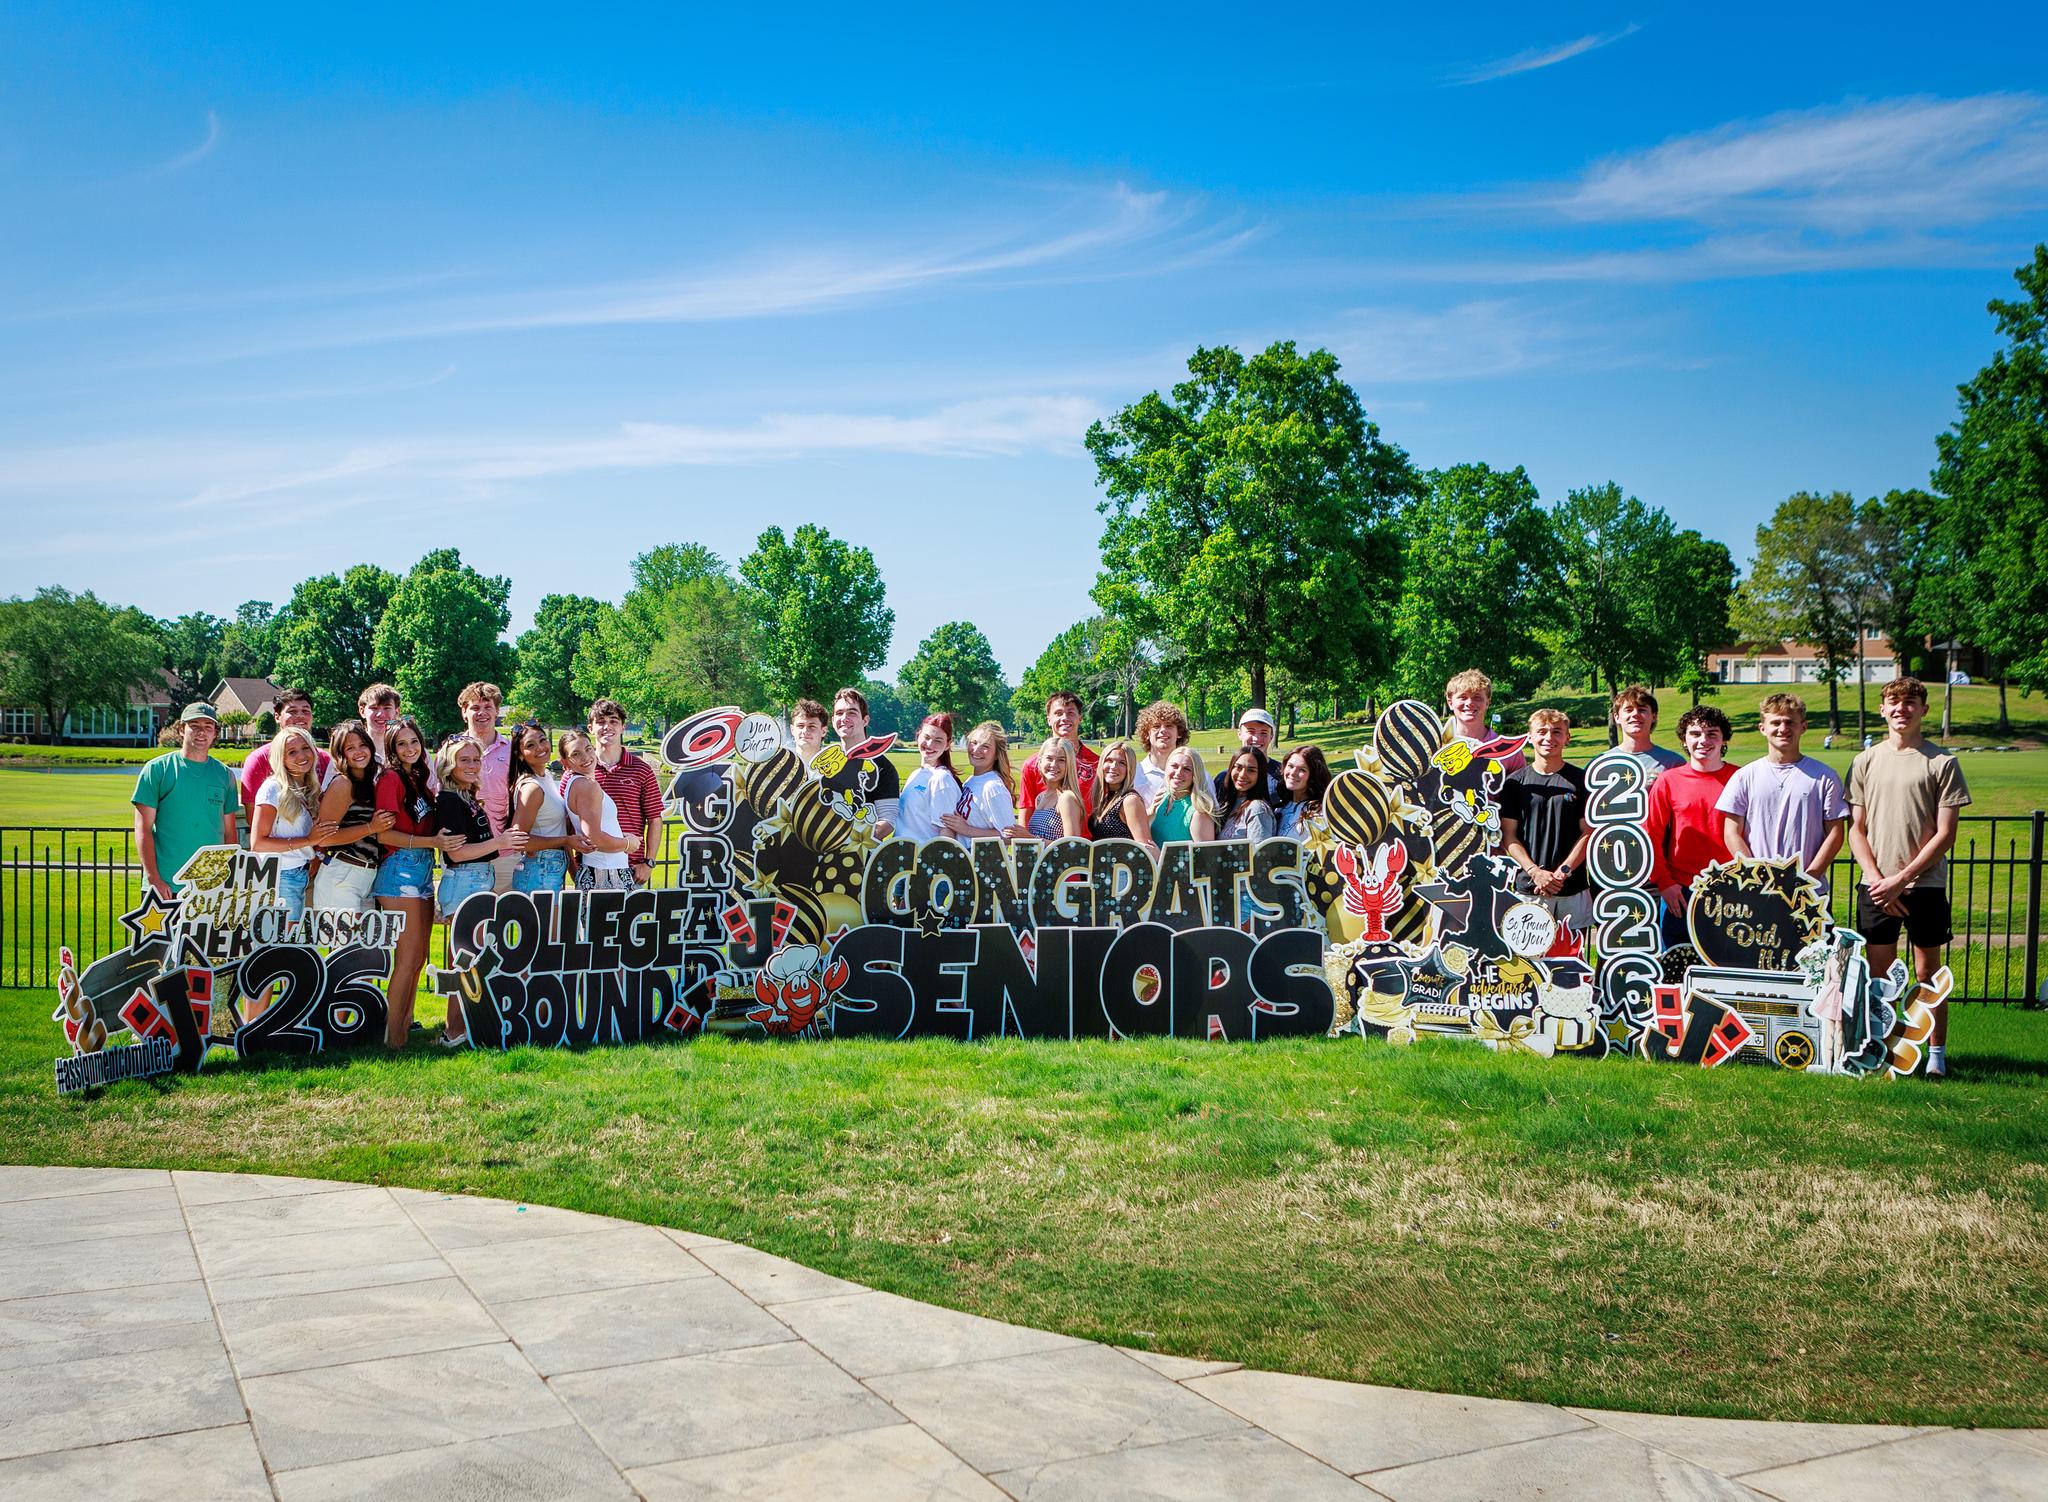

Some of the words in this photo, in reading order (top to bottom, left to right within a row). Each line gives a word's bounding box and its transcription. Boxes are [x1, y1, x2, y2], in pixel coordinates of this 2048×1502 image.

[749, 721, 772, 739] You
[224, 854, 279, 890] I'M
[862, 837, 1306, 934] CONGRATS
[1586, 756, 1664, 1020] 2026
[1506, 917, 1518, 931] So
[1521, 913, 1551, 931] Proud
[1704, 894, 1753, 927] You
[252, 908, 356, 950] CLASS
[361, 909, 404, 950] OF
[451, 890, 690, 973] COLLEGE
[1511, 930, 1521, 945] of
[1520, 930, 1550, 951] You!
[1726, 921, 1781, 949] Did
[237, 945, 394, 1056] 26
[827, 923, 1336, 1042] SENIORS
[1411, 983, 1442, 999] GRAD!
[1469, 978, 1528, 996] adventure
[490, 968, 681, 1048] BOUND
[1467, 992, 1534, 1011] BEGINS
[56, 1037, 173, 1094] #assignmentcomplete
